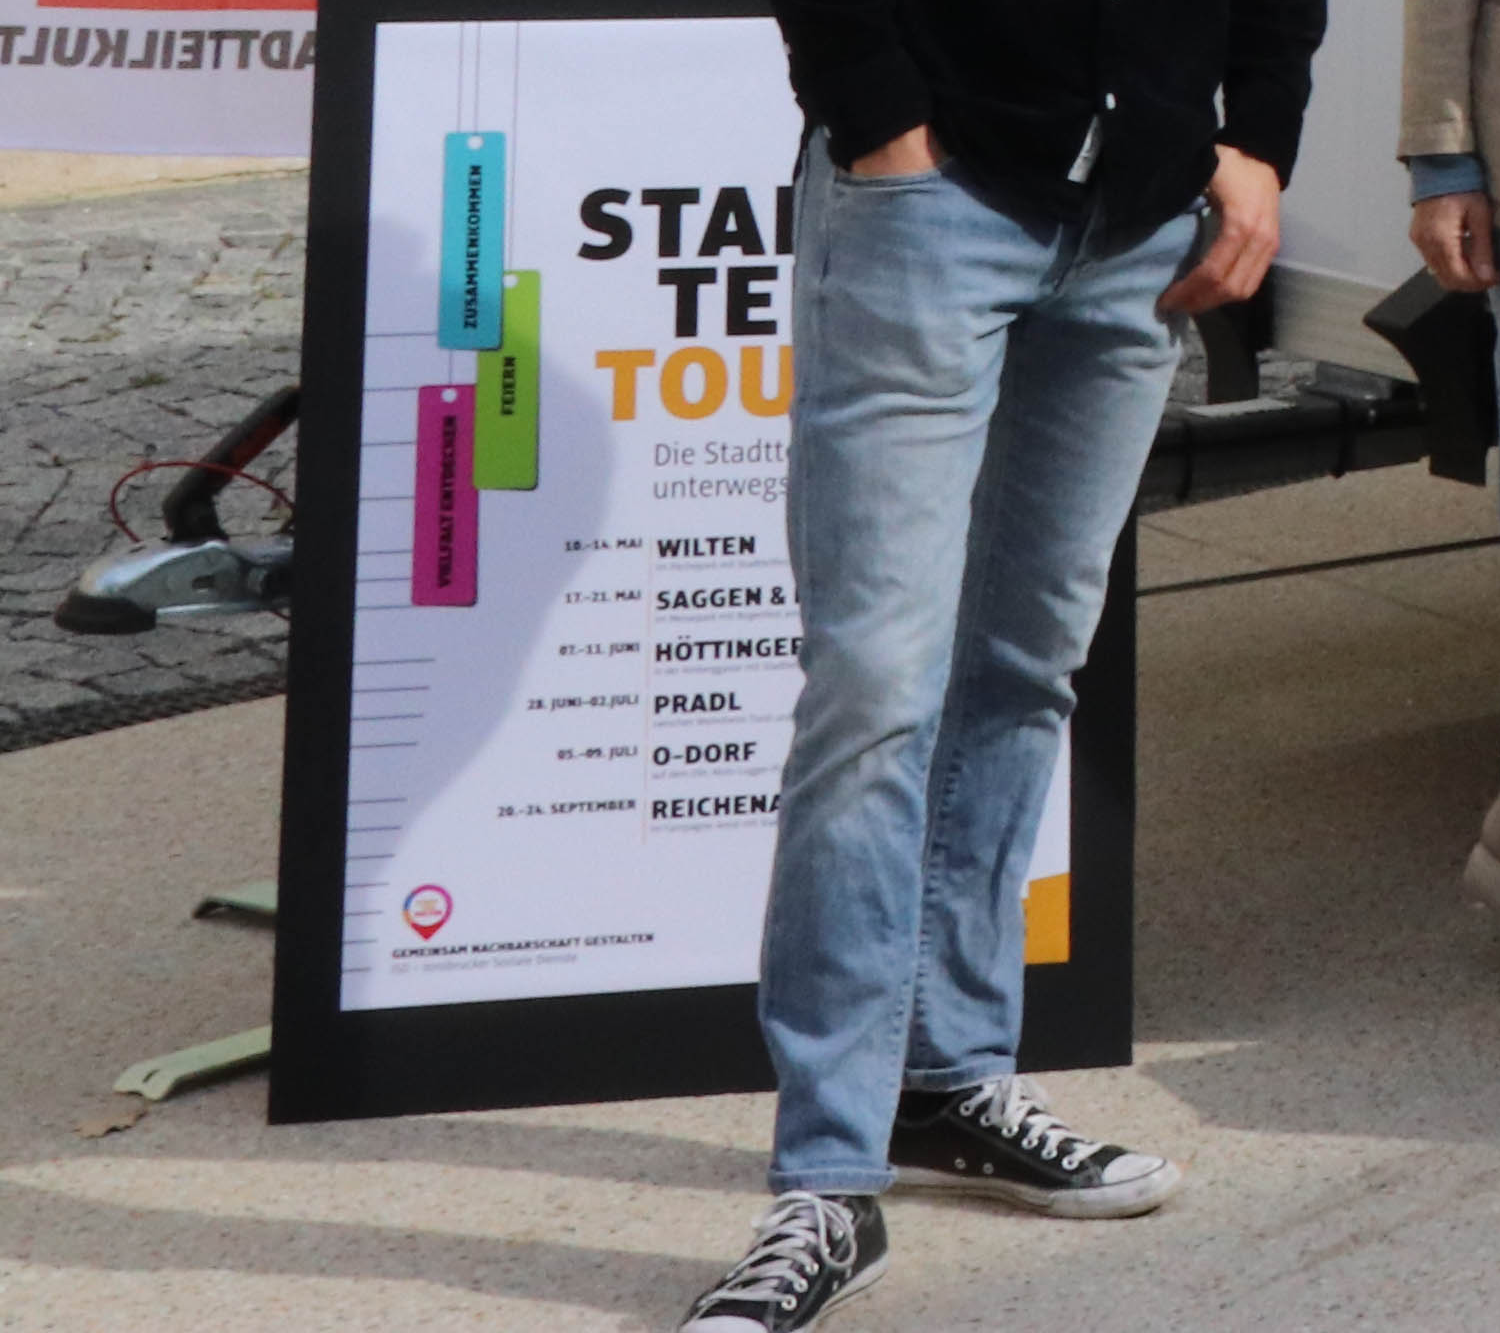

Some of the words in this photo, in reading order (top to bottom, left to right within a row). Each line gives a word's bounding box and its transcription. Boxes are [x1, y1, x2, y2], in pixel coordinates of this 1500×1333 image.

[464, 164, 482, 329] ZUSAMMENKOMMEN
[500, 355, 516, 416] FEIERN
[654, 442, 695, 467] Die
[616, 538, 643, 550] MAI
[656, 535, 757, 558] WILTEN
[615, 590, 642, 601] MAI
[656, 586, 762, 610] SAGGEN
[769, 586, 786, 606] &
[608, 641, 640, 657] JUNI
[654, 692, 742, 714] PRADL
[608, 747, 638, 760] JULI
[652, 741, 758, 765] O-DORF
[551, 799, 636, 814] SEPTEMBER
[391, 944, 468, 959] GEMEINSAM
[472, 937, 580, 954] NACHBARSCHAFT
[583, 932, 655, 947] GESTALTEN
